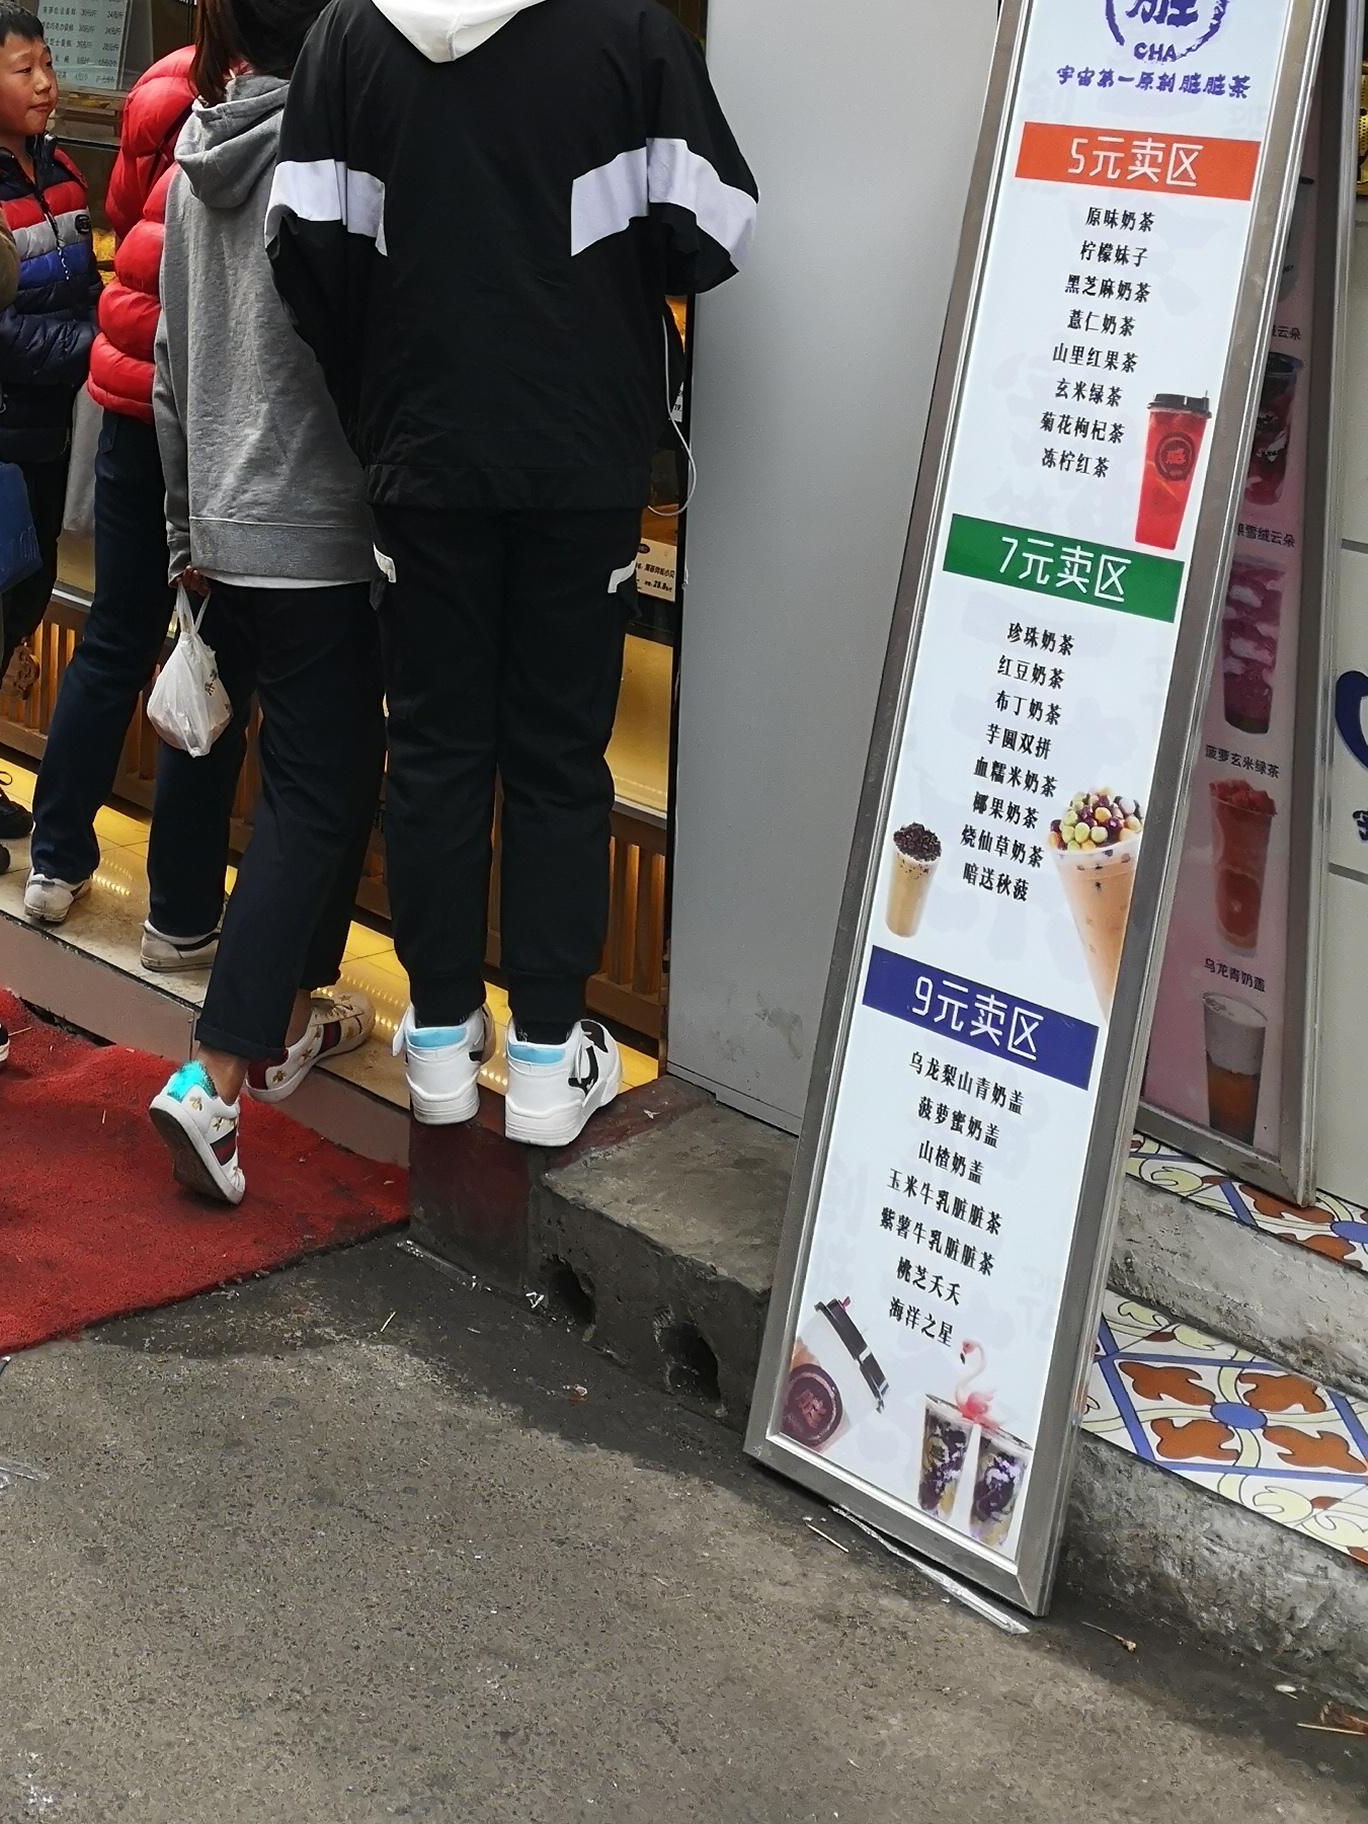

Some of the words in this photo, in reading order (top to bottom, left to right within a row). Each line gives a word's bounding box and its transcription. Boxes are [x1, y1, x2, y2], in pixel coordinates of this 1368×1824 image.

[1133, 42, 1177, 63] CHA
[1067, 136, 1204, 188] 5元卖区
[1085, 207, 1155, 232] 原味奶茶
[1079, 240, 1148, 268] 柠檬妹子
[1064, 274, 1152, 304] 黑芝麻奶茶
[1067, 309, 1136, 337] 薏仁奶茶
[1052, 342, 1138, 373] 山里红果茶
[1055, 378, 1123, 408] 玄米绿茶
[1040, 411, 1126, 444] 菊花枸杞茶
[1041, 447, 1110, 478] 冻柠红茶
[999, 536, 1132, 603] 7元卖区
[1007, 622, 1075, 656] 珍珠奶茶
[997, 655, 1065, 690] 红豆奶茶
[994, 690, 1062, 726] 布丁奶茶
[985, 723, 1052, 760] 芋圆双拼
[973, 756, 1057, 799] 血糯米奶茶
[972, 792, 1039, 829] 椰果奶茶
[961, 824, 1045, 869] 烧仙草奶茶
[963, 862, 1030, 903] 暗送秋菠
[912, 975, 1045, 1062] 9元卖区
[908, 1051, 1024, 1116] 乌龙梨山青奶盖
[917, 1095, 1001, 1148] 菠萝蜜奶盖
[918, 1139, 983, 1184] 山楂奶盖
[887, 1168, 1003, 1237] 玉米牛乳脏脏茶
[880, 1206, 995, 1277] 紫薯牛乳脏脏茶
[889, 1297, 954, 1348] 海洋之星
